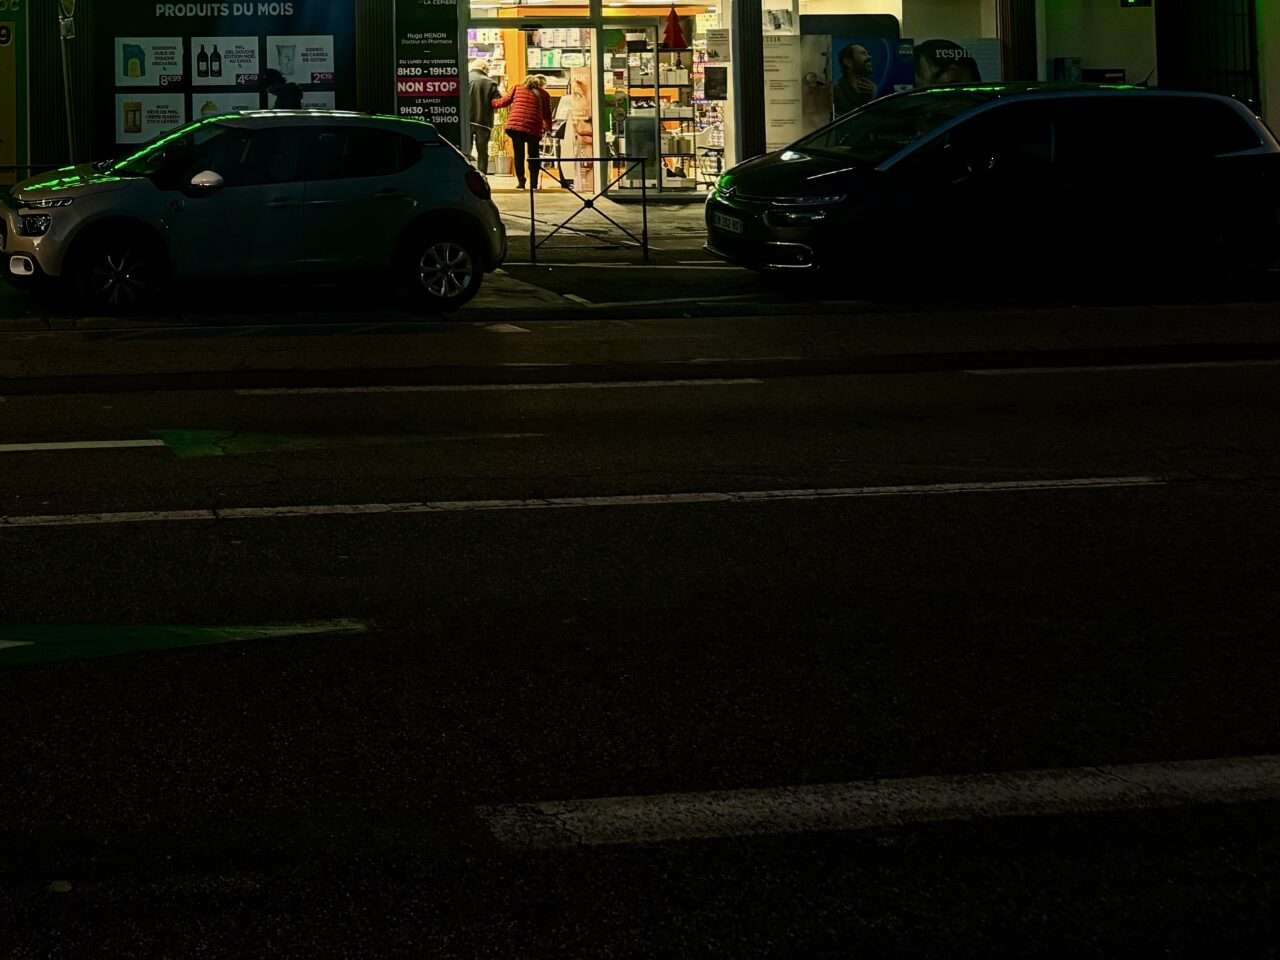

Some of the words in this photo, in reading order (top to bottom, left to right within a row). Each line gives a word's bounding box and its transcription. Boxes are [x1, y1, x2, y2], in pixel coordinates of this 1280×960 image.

[155, 1, 231, 17] PRODUITS
[233, 2, 255, 17] DU
[257, 1, 294, 16] MOIS
[397, 67, 422, 76] 8H30
[429, 67, 458, 76] 19H30
[397, 81, 424, 92] NON
[426, 81, 457, 92] STOP
[400, 106, 424, 114] 9H30
[429, 106, 457, 114] 13H00
[431, 115, 459, 123] 19H00
